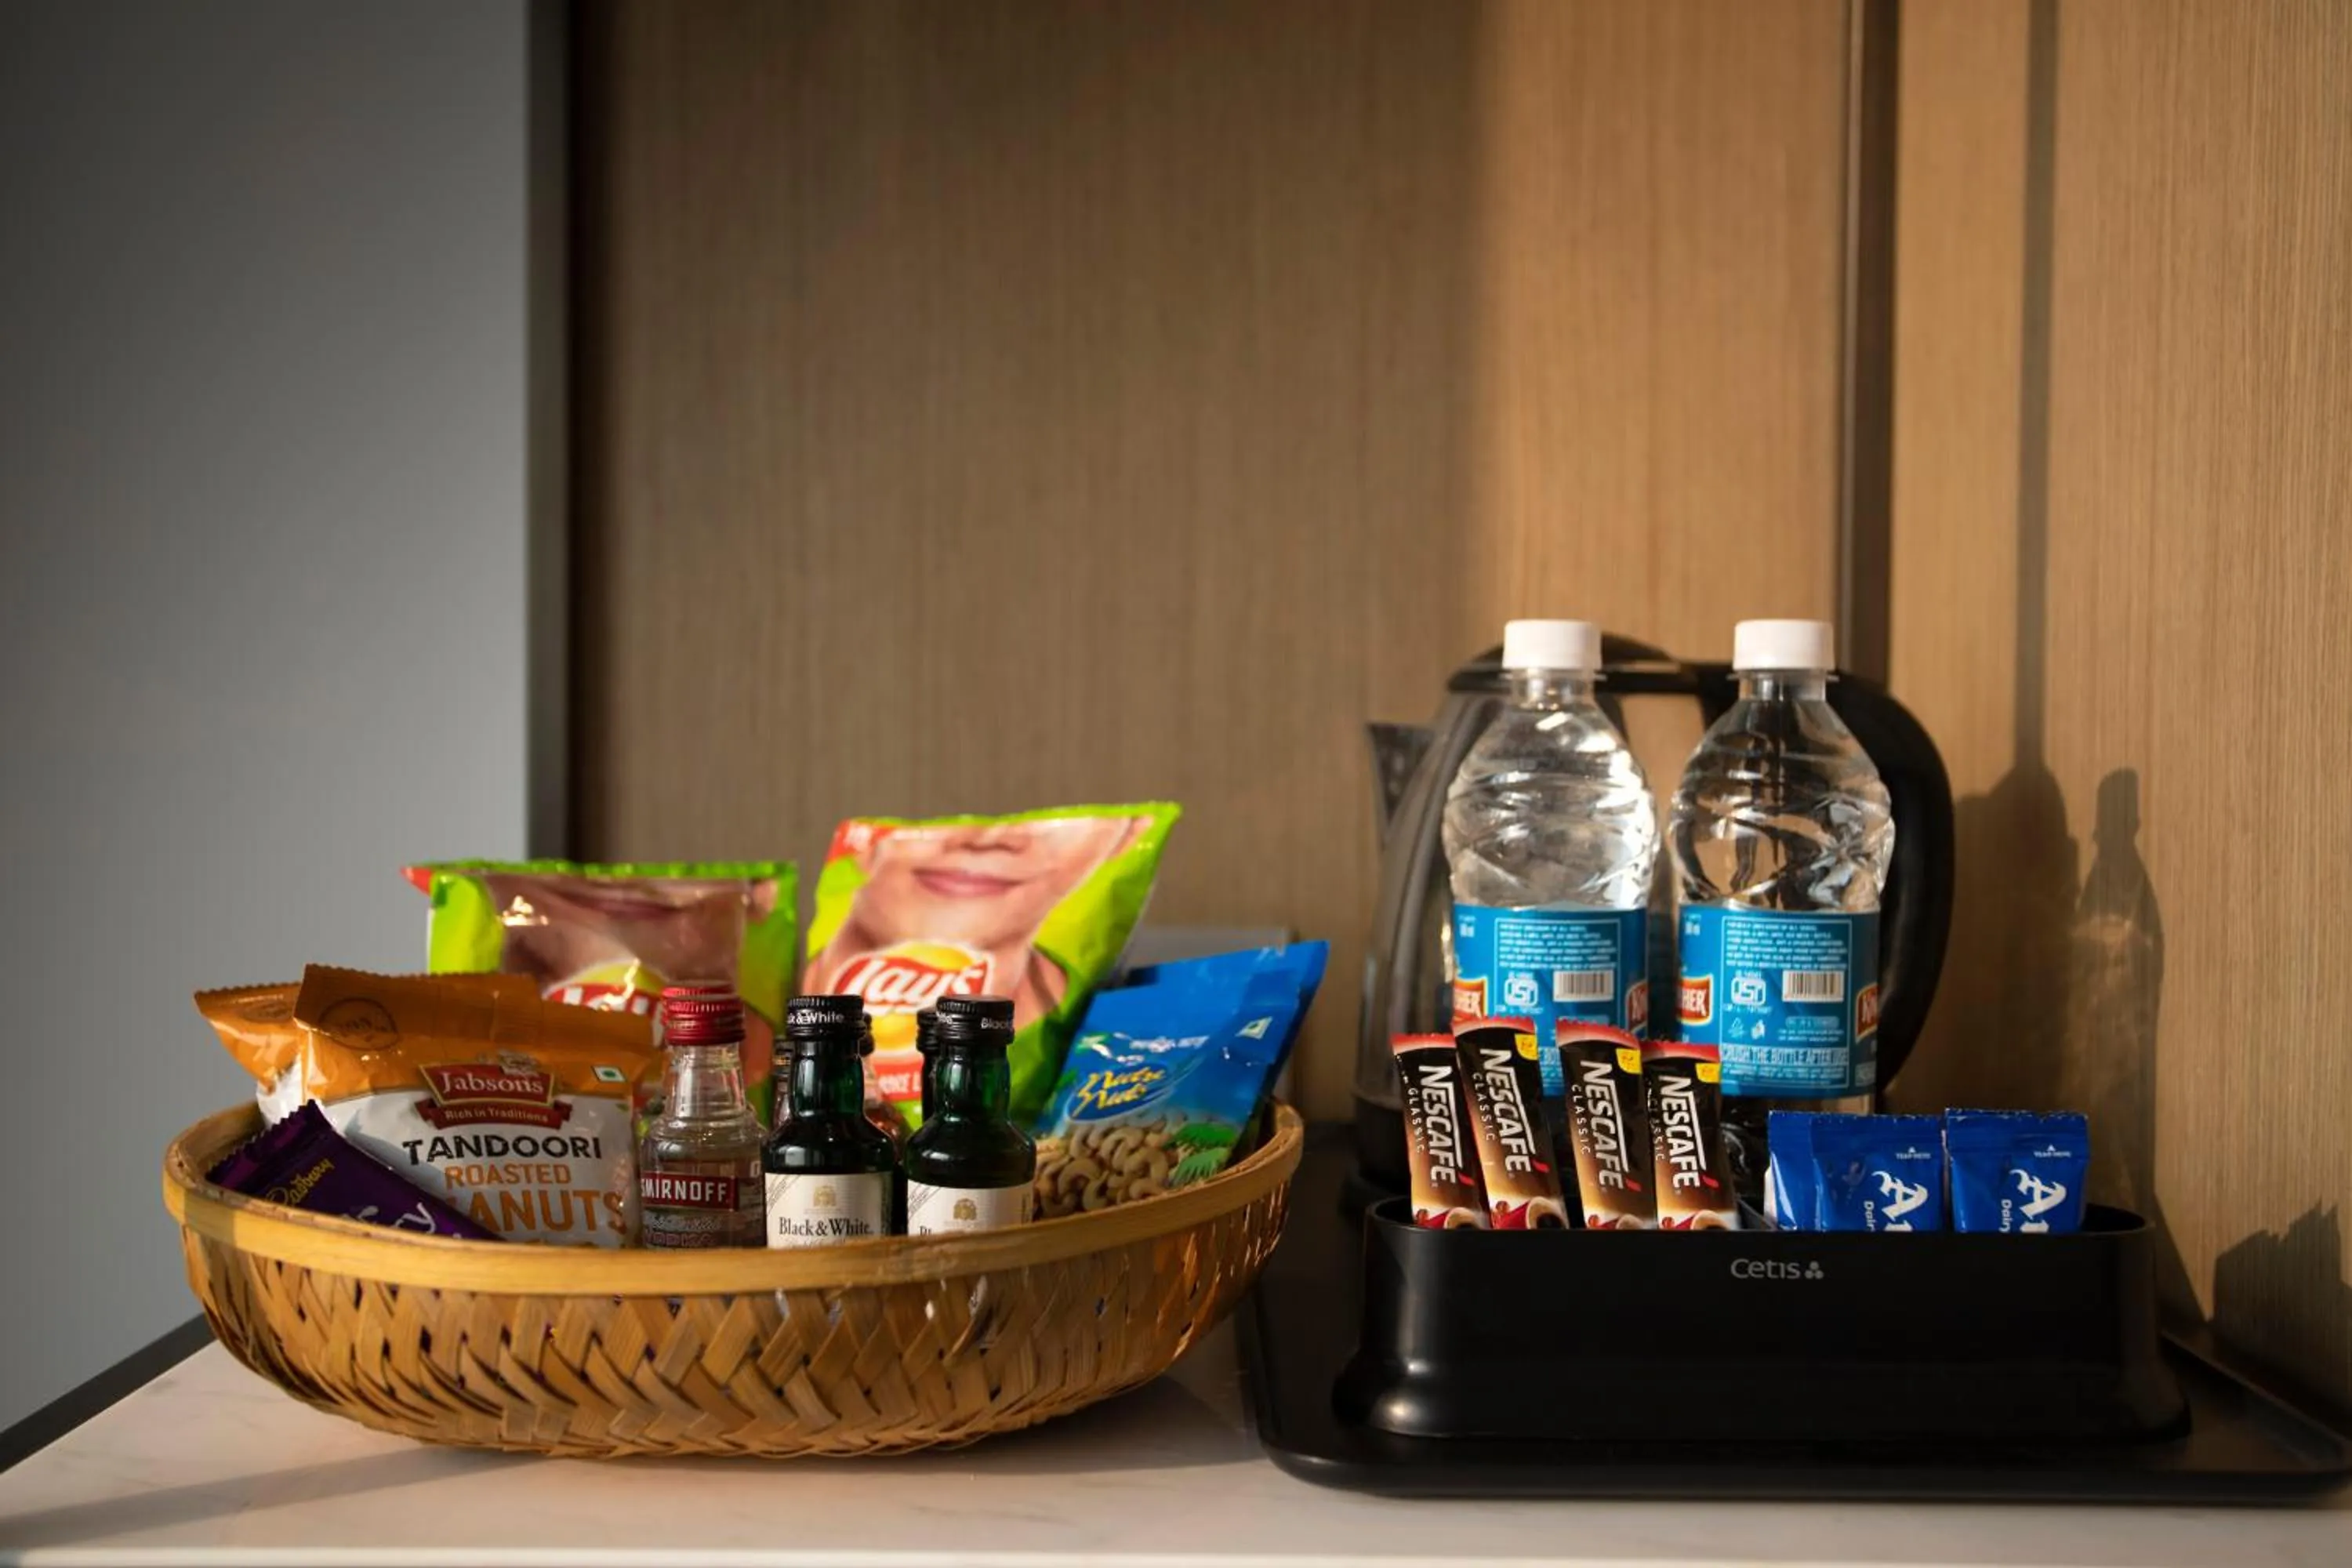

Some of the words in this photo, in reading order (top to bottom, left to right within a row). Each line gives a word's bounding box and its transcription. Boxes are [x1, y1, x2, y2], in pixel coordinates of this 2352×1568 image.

[441, 1071, 545, 1094] Jabsons
[445, 1109, 473, 1120] Rich
[474, 1108, 486, 1117] in
[488, 1107, 548, 1122] Traditions
[1472, 1072, 1495, 1142] CLASSIC
[1571, 1084, 1591, 1156] CLASSIC
[402, 1134, 602, 1165] TANDOORI
[445, 1163, 572, 1189] ROASTED
[641, 1178, 728, 1203] SMIRNOFF
[445, 1189, 627, 1235] ANUTS
[1730, 1258, 1802, 1279] Cetis
